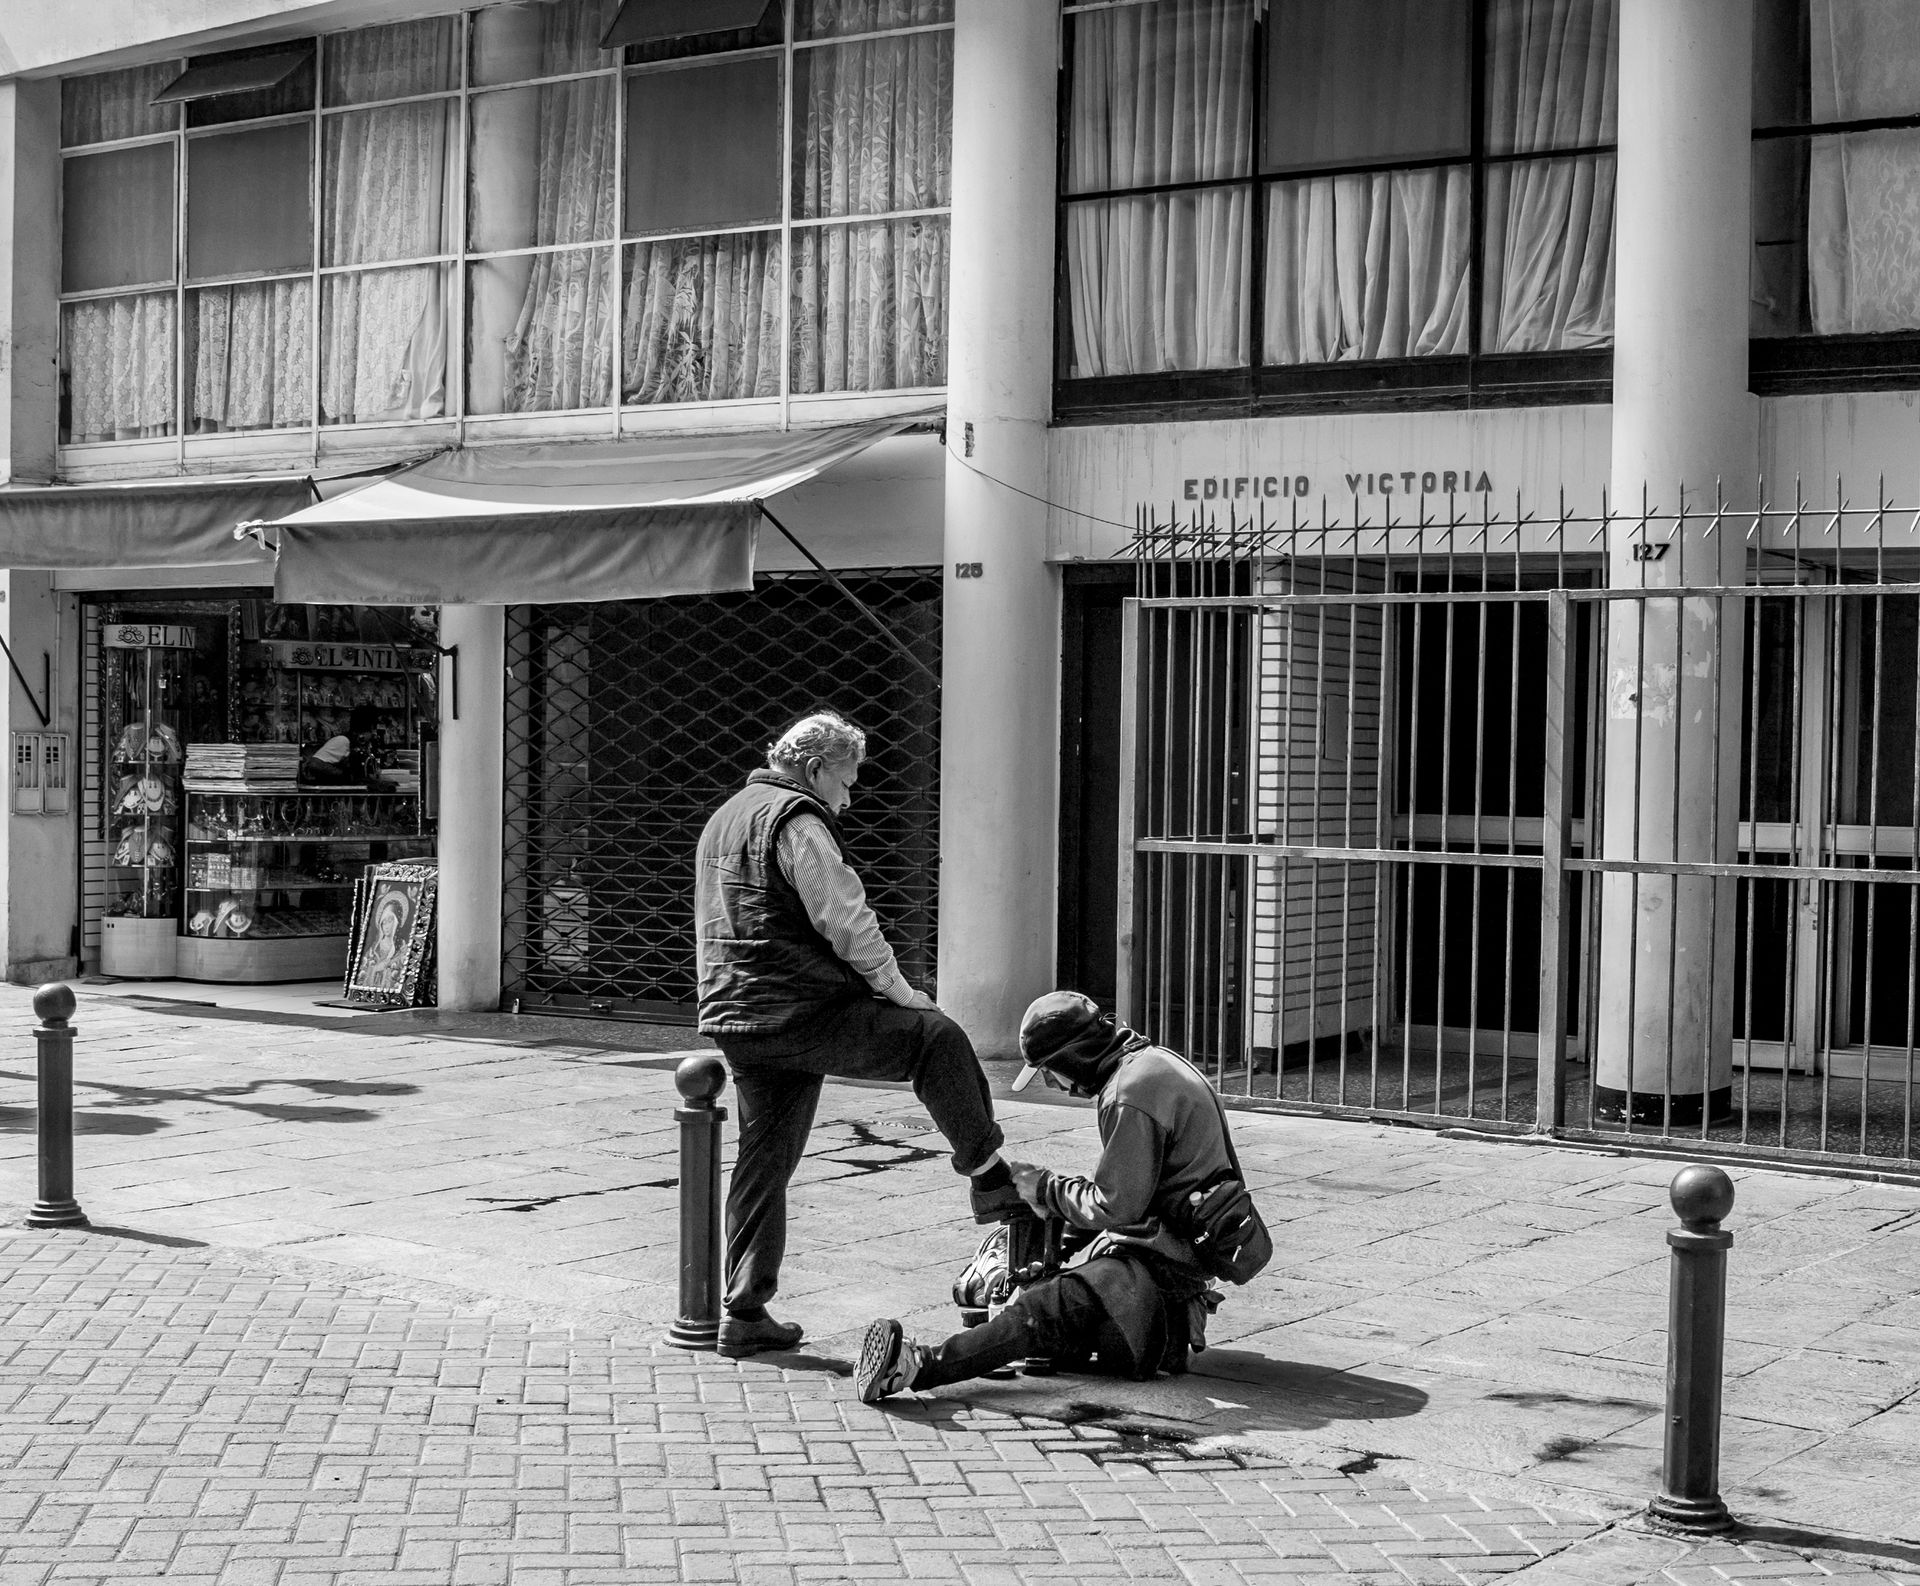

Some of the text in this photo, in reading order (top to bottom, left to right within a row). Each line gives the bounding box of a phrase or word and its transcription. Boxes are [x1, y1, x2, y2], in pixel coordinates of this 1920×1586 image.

[1184, 470, 1493, 500] EDIFICIO VICTORIA
[1633, 543, 1670, 561] 127
[147, 625, 175, 647] EL
